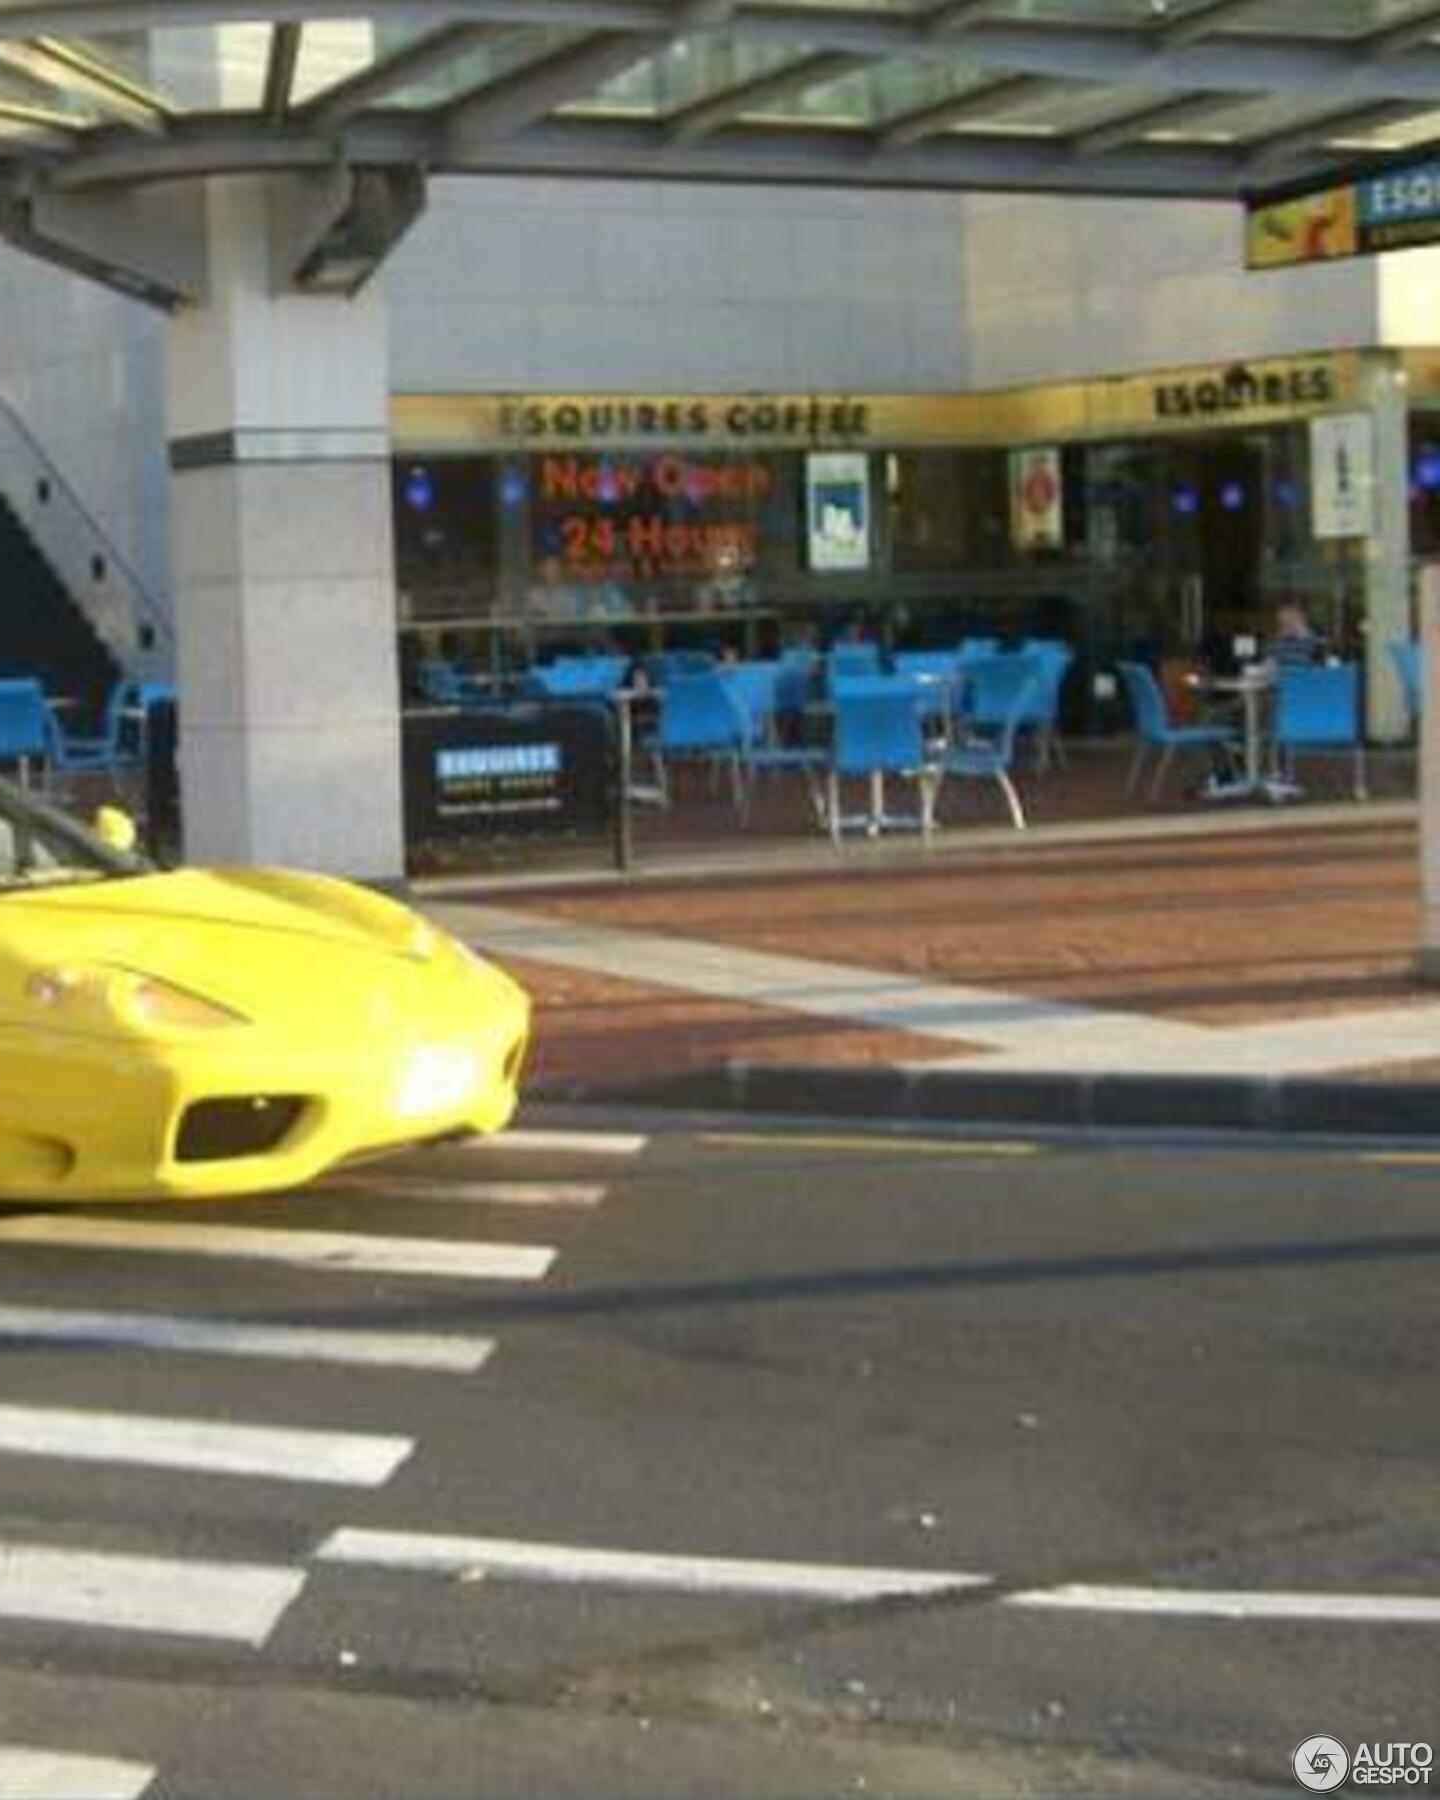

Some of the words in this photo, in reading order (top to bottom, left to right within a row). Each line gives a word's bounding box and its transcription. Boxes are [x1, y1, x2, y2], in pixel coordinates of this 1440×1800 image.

[1371, 172, 1440, 214] ESQ
[1154, 368, 1328, 415] ESQUIRES
[501, 404, 707, 436] ESQUIRES
[726, 403, 868, 434] COFFEE
[542, 458, 637, 497] Now
[655, 456, 769, 502] Open
[564, 516, 614, 556] 24
